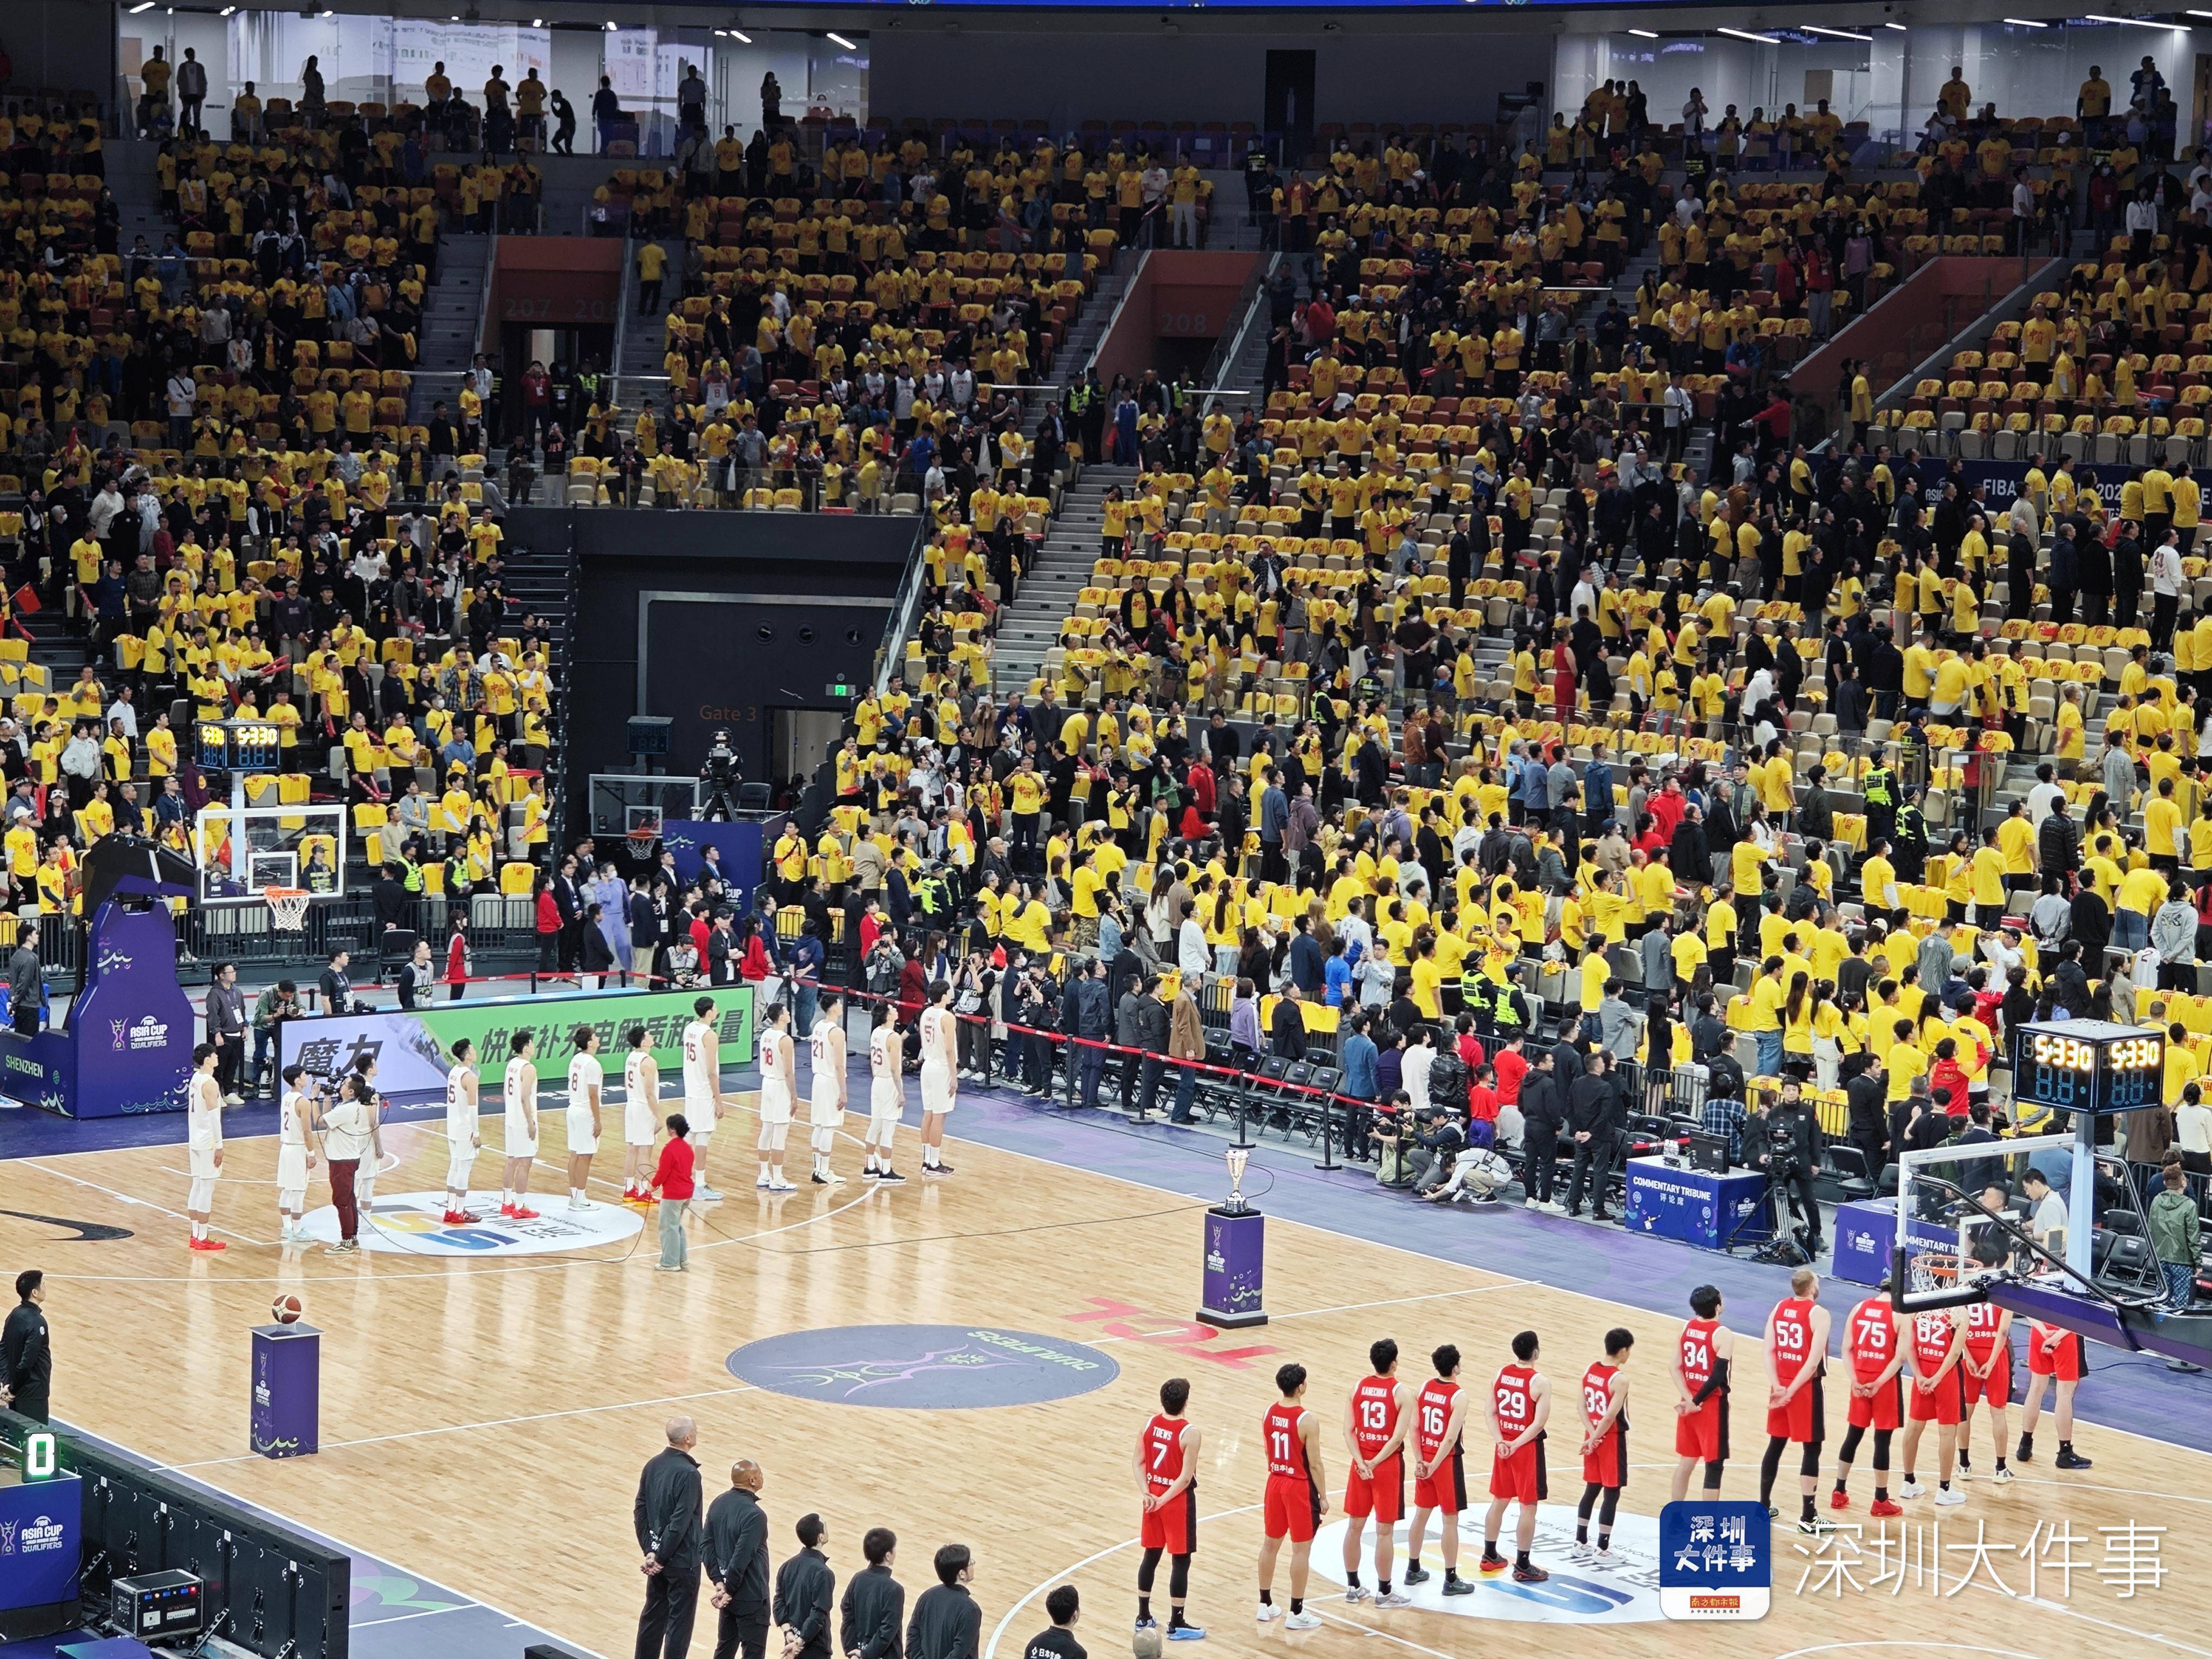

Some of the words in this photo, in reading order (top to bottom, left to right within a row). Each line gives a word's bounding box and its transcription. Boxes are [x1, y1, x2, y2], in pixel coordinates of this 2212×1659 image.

[1162, 313, 1208, 333] 208
[1982, 478, 2018, 496] FIBA
[699, 704, 741, 721] Gate
[747, 706, 757, 721] 3
[130, 1026, 150, 1038] ASIA
[151, 1024, 168, 1036] CUP
[925, 1025, 936, 1044] 51
[130, 1040, 167, 1049] QUALIFIERS
[685, 1041, 697, 1062] 15
[813, 1039, 824, 1060] 21
[296, 1034, 383, 1077] 魔力
[762, 1046, 773, 1066] 18
[5, 1055, 44, 1078] SHENZHEN
[508, 1077, 514, 1095] 6
[571, 1073, 578, 1091] 8
[628, 1070, 634, 1088] 9
[448, 1084, 456, 1104] 5
[284, 1111, 289, 1131] 2
[1633, 1176, 1681, 1194] COMMENTARY
[1681, 1186, 1711, 1201] TRIBUNE
[1967, 1302, 1994, 1327] 91
[1776, 1320, 1803, 1348] 53
[1857, 1319, 1887, 1348] 75
[1917, 1317, 1945, 1346] 82
[967, 1330, 1100, 1371] QUALIFIERS
[1683, 1341, 1708, 1370] 34
[1497, 1388, 1526, 1419] 29
[1584, 1386, 1608, 1417] 33
[1272, 1415, 1289, 1428] TSUYA
[1360, 1400, 1386, 1429] 13
[1421, 1405, 1444, 1435] 16
[1152, 1426, 1173, 1441] TOEWS
[1366, 1432, 1390, 1441] 日本生命
[1503, 1421, 1526, 1432] 日本生命
[28, 1433, 55, 1476] 0
[1152, 1441, 1167, 1469] 7
[1271, 1431, 1289, 1460] 11
[22, 1526, 43, 1541] ASIA
[44, 1524, 64, 1537] CUP
[22, 1541, 63, 1553] QUALIFIERS
